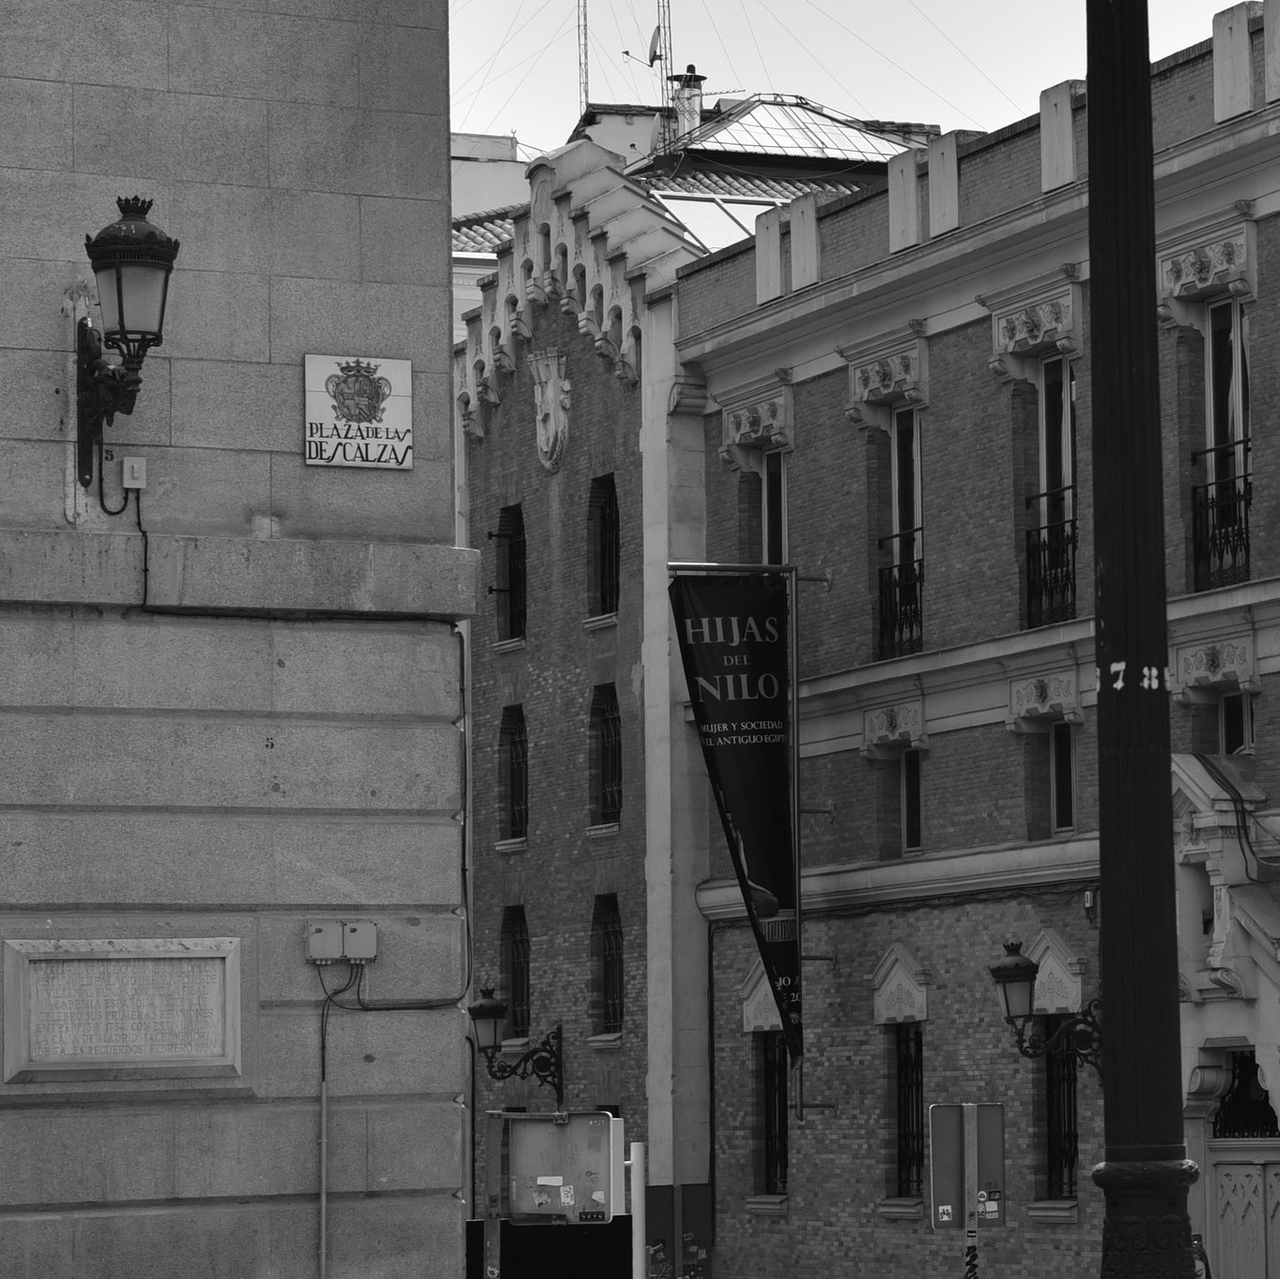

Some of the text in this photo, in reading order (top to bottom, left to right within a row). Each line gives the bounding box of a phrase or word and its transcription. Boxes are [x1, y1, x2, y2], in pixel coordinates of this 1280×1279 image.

[308, 422, 411, 442] PLAZA DE LAS
[306, 440, 413, 466] DESCALZAS
[684, 616, 779, 647] HIJAS
[723, 654, 752, 666] DEL
[693, 672, 779, 703] NILO
[731, 721, 738, 732] Y
[740, 720, 784, 731] SOCIEDAD
[716, 734, 764, 746] ANTIGUO
